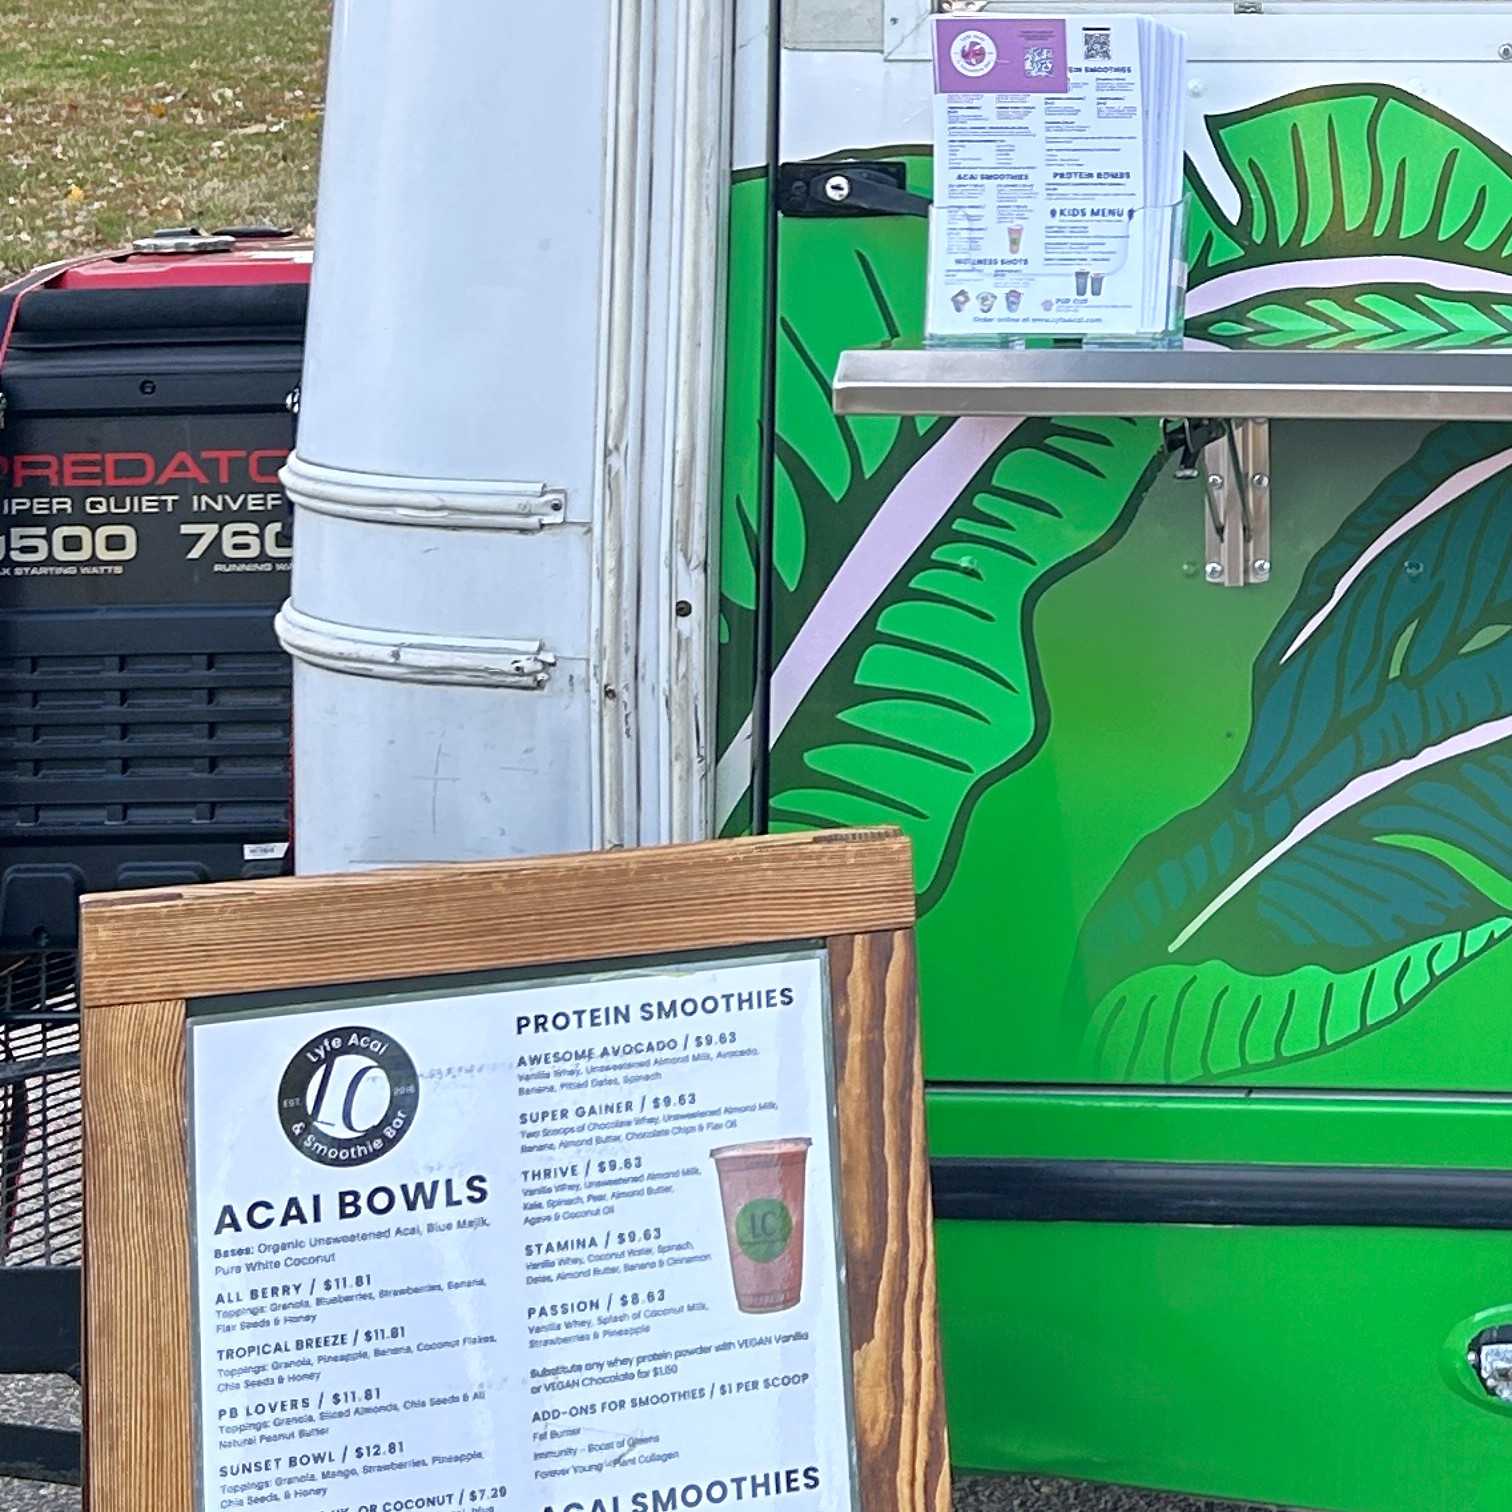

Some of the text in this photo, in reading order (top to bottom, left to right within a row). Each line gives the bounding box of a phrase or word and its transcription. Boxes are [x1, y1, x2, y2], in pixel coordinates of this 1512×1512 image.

[1059, 207, 1124, 218] KIDS MENU
[0, 448, 290, 488] REDATO
[85, 495, 180, 514] QUIET
[0, 523, 138, 562] 500
[13, 566, 78, 576] STARTING
[80, 565, 125, 575] WATTS
[516, 987, 794, 1035] PROTEIN SMOOTHIES
[305, 1032, 390, 1063] Lyfe Acai
[517, 1048, 595, 1067] AWESOME
[599, 1038, 678, 1059] AVOCADO
[519, 1108, 569, 1125] SUPER
[575, 1100, 633, 1118] GAINER
[303, 1133, 384, 1161] Smoothie
[382, 1109, 408, 1140] Bar
[521, 1164, 578, 1182] THRIVE
[214, 1174, 489, 1236] ACAI BOWLS
[257, 1239, 306, 1254] Organic
[525, 1236, 598, 1256] STAMINA
[215, 1292, 243, 1305] ALL
[250, 1283, 302, 1300] BERRY
[323, 1274, 371, 1292] $11.81
[527, 1299, 599, 1320] PASSION
[217, 1341, 291, 1361] TROPICAL
[295, 1334, 347, 1351] BREEZE
[364, 1326, 405, 1343] $11.81
[218, 1407, 238, 1421] PB
[246, 1398, 310, 1417] LOVERS
[332, 1387, 380, 1405] $11.81
[532, 1403, 597, 1423] ADD-ONS
[601, 1399, 625, 1413] FOR
[630, 1387, 706, 1408] SMOOTHIES
[736, 1380, 759, 1393] PER
[763, 1373, 809, 1389] SCOOP
[219, 1458, 282, 1477] SUNSET
[288, 1451, 335, 1468] BOWL
[355, 1441, 403, 1459] $12.81
[382, 1493, 454, 1512] COCONUT
[469, 1486, 507, 1502] $7.20
[631, 1466, 820, 1512] SMOOTHIES
